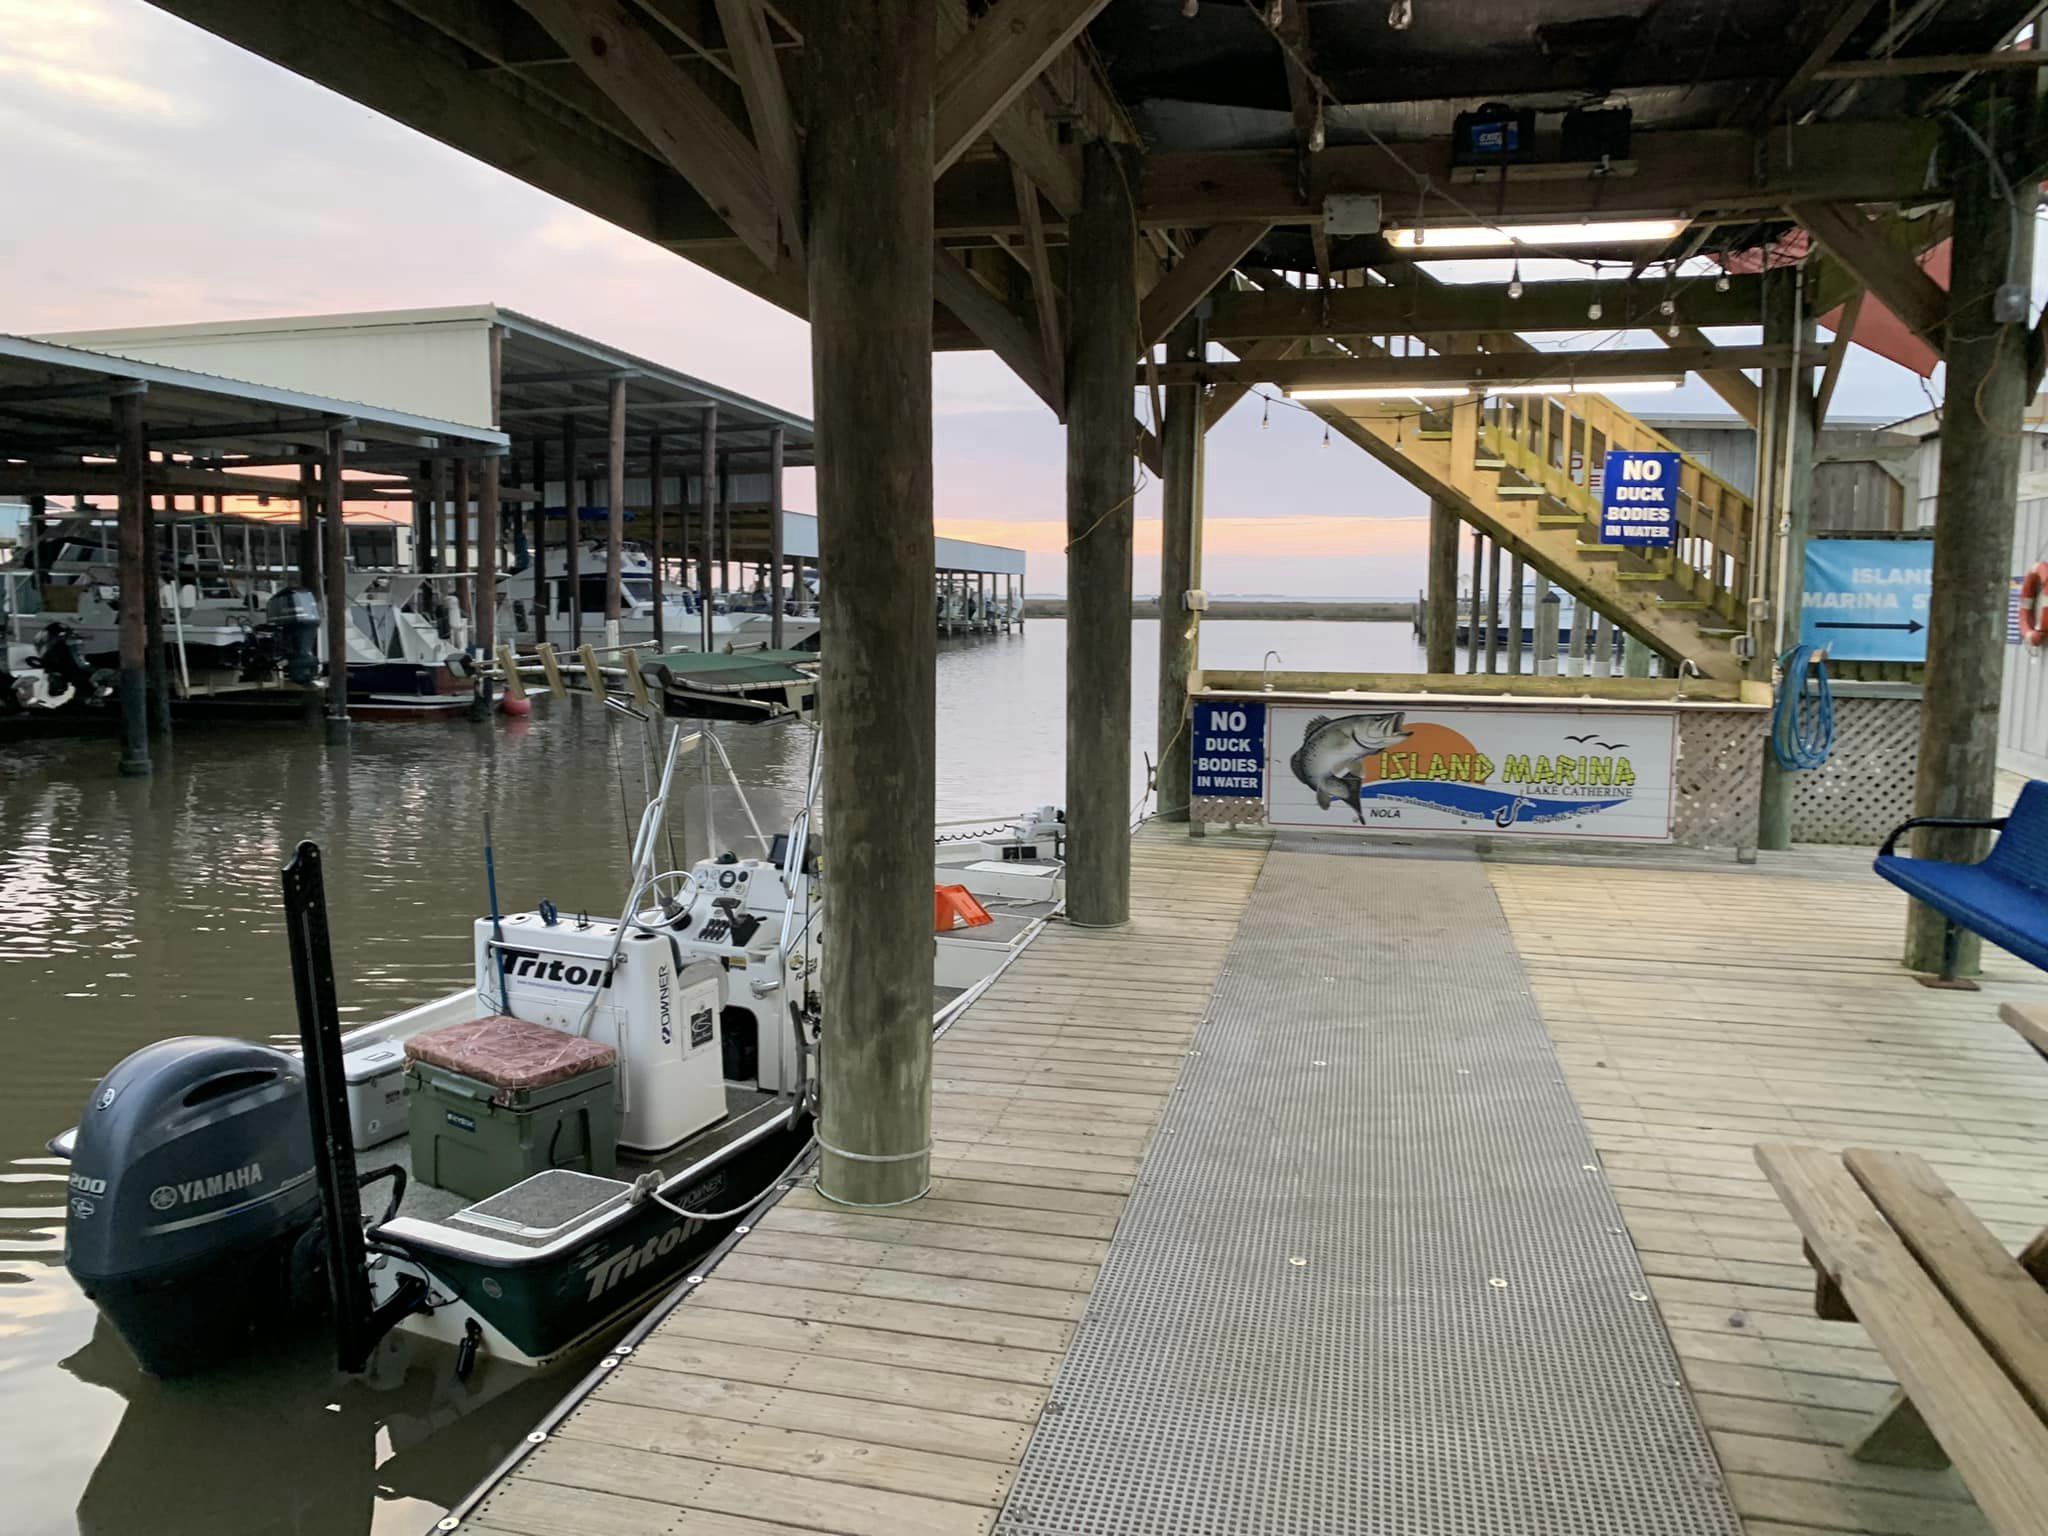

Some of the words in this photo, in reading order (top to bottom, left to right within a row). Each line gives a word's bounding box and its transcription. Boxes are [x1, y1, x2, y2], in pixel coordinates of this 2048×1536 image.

[1622, 460, 1662, 481] NO
[1616, 487, 1665, 501] DUCK
[1607, 507, 1670, 521] BODIES
[1605, 525, 1621, 536] IN
[1623, 526, 1669, 537] WATER
[1801, 592, 1899, 609] MARINA
[1211, 711, 1247, 732] NO
[1205, 738, 1251, 752] DUCK
[1198, 758, 1258, 772] BODIES
[1380, 751, 1495, 783] ISLAND
[1502, 753, 1636, 786] MARINA
[1197, 776, 1211, 787] IN
[1213, 777, 1258, 788] WATER
[1526, 785, 1559, 796] LAKE
[1562, 786, 1633, 797] CATHERINE
[1370, 809, 1401, 819] NOLA
[501, 949, 615, 989] Triton
[658, 964, 671, 1027] OWNER
[69, 1173, 107, 1194] 200
[177, 1163, 263, 1204] YAMAHA
[585, 1216, 705, 1303] Triton
